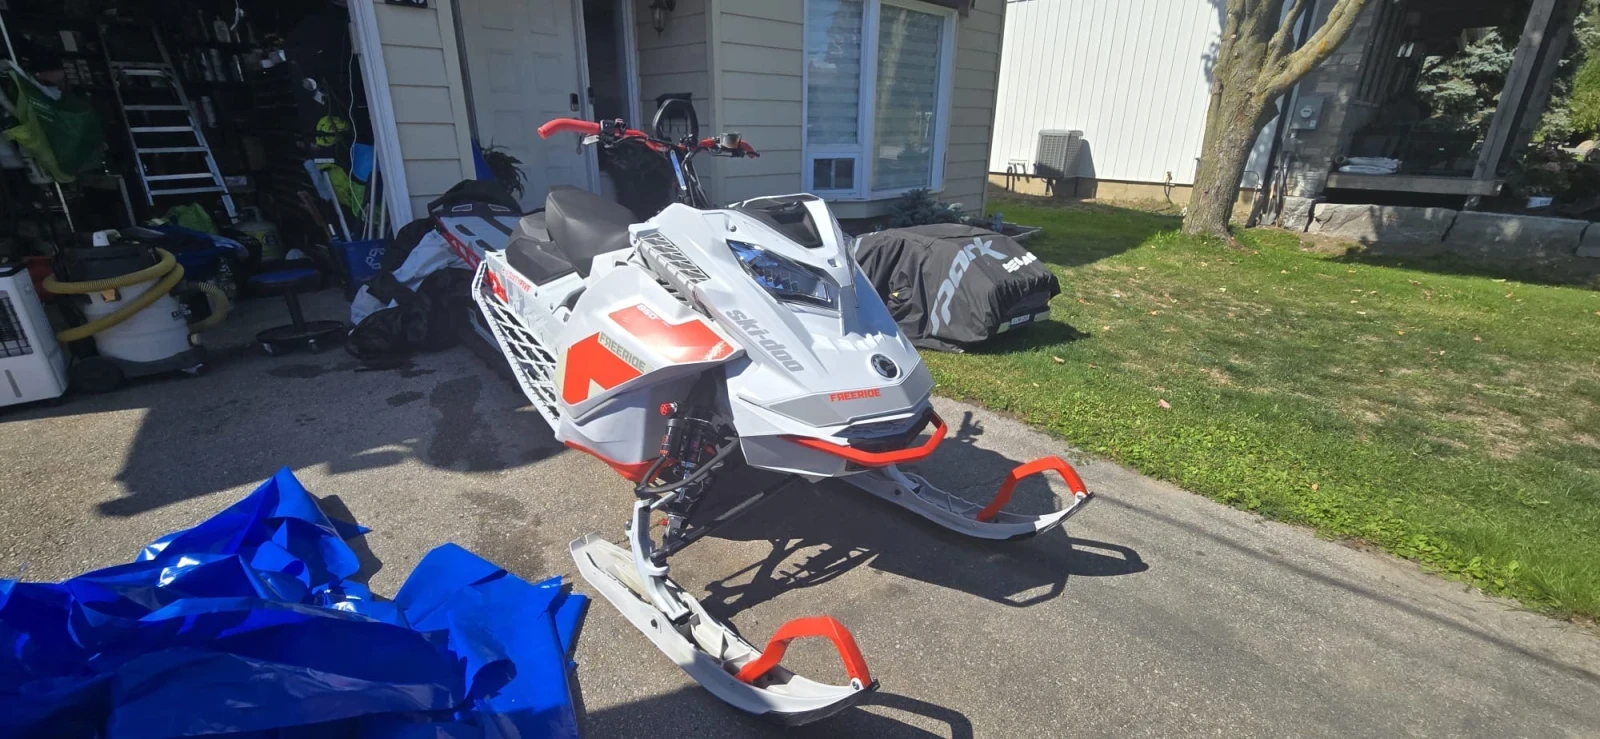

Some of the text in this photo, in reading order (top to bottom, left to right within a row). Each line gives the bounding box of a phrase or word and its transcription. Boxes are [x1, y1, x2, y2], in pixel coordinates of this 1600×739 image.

[636, 303, 658, 321] 850
[600, 331, 646, 373] FREERIDE
[725, 309, 805, 372] ski-doo
[829, 388, 882, 402] FREERIDE
